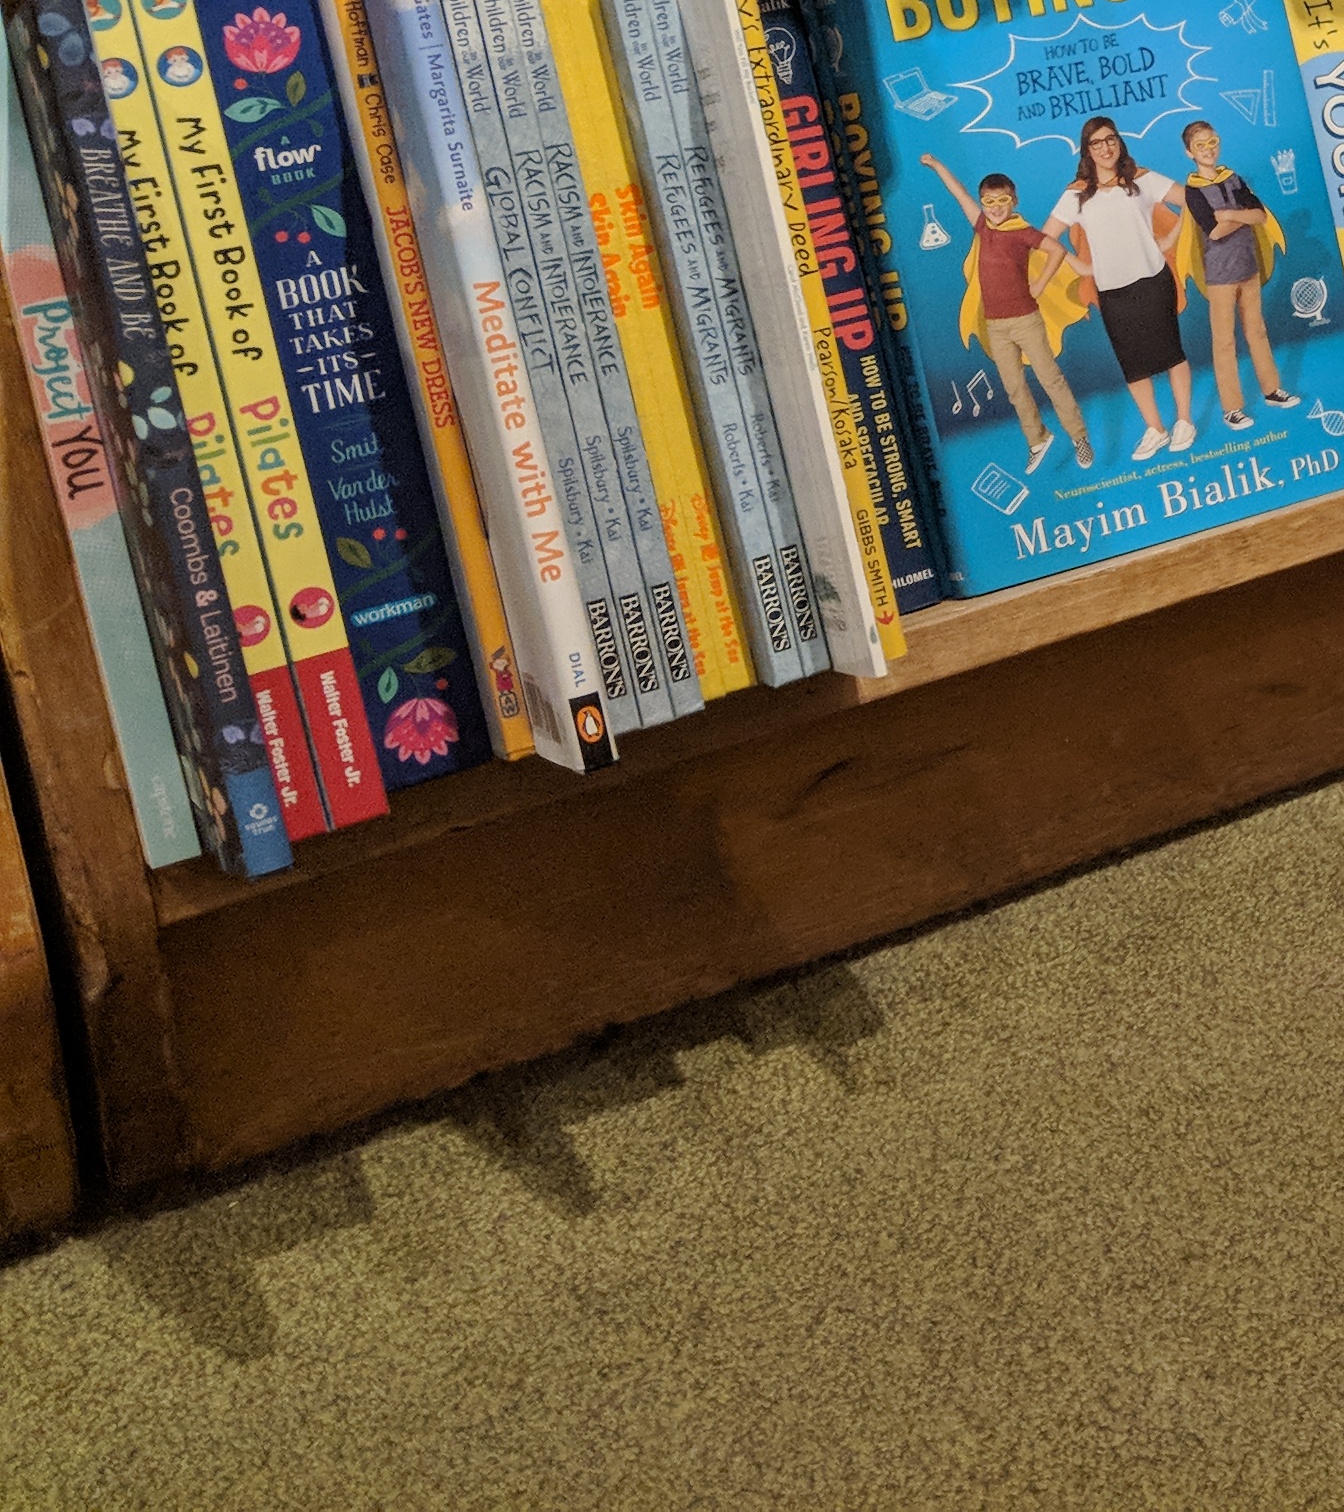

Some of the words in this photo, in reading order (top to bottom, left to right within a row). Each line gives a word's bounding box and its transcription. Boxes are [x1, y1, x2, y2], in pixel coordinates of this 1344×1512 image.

[1016, 59, 1095, 96] BRAVE,
[1099, 47, 1155, 78] BOLD
[1044, 40, 1079, 61] HOW
[1103, 34, 1118, 49] BE
[427, 54, 455, 137] Margarita
[1017, 102, 1046, 122] AND
[1049, 74, 1169, 120] BRILLIANT
[176, 117, 206, 155] My
[254, 144, 322, 172] flow
[191, 165, 235, 239] First
[214, 246, 254, 322] Book
[276, 266, 368, 311] BOOK
[289, 301, 358, 332] THAT
[289, 322, 374, 356] TAKES
[409, 300, 436, 353] NEW
[232, 329, 262, 362] of
[301, 370, 386, 414] TIME
[422, 359, 455, 429] DRESS
[471, 279, 526, 434] Meditate
[512, 441, 547, 519] with
[531, 530, 562, 584] Me
[1190, 440, 1251, 466] bestselling
[1252, 429, 1289, 447] author
[896, 493, 923, 549] SMART
[1010, 501, 1147, 560] Mayim
[1158, 457, 1285, 519] Bialik,
[1290, 448, 1340, 481] PhD
[171, 488, 207, 586] Coombs
[866, 560, 888, 607] SMITH
[353, 594, 435, 625] workman
[588, 599, 627, 699] BARRON'S
[620, 592, 658, 692] BARRON'S
